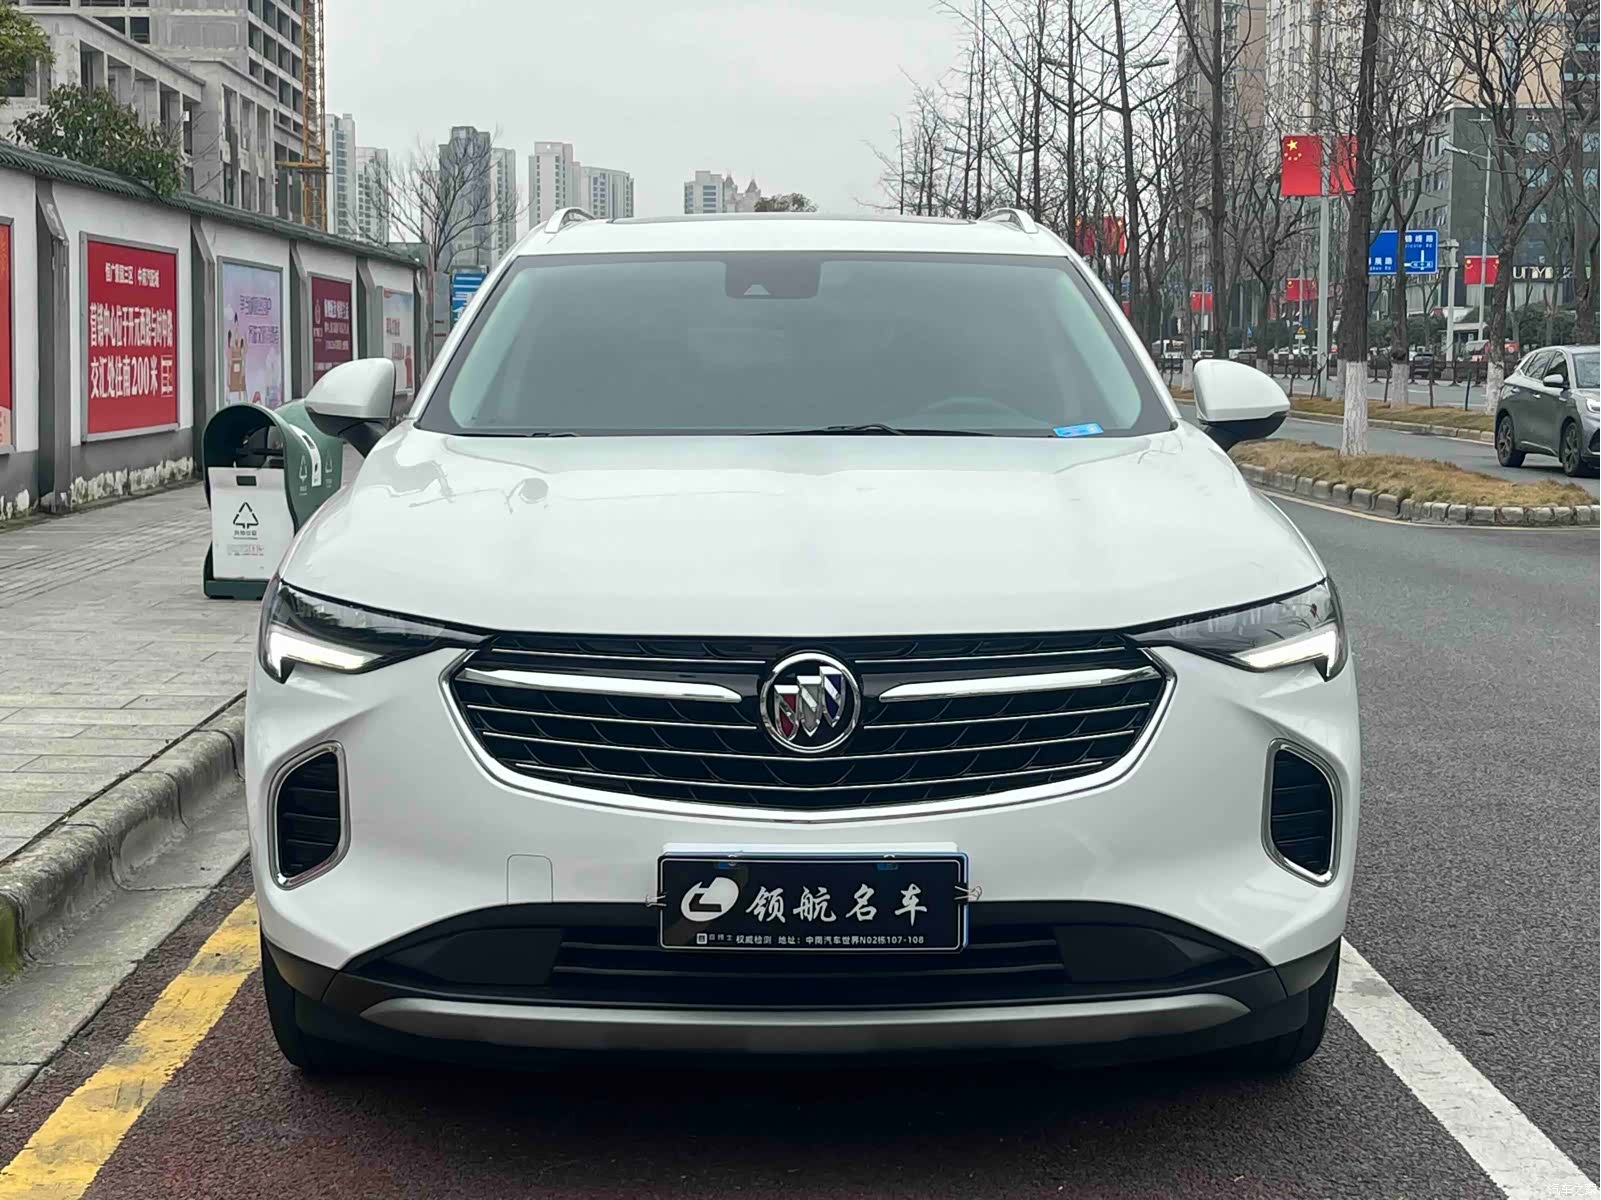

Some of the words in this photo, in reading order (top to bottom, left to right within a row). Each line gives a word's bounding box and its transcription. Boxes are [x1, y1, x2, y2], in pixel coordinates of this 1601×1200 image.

[90, 354, 158, 399] 交汇处往南200米
[745, 883, 929, 926] 领航名车
[735, 935, 772, 945] 权威检测
